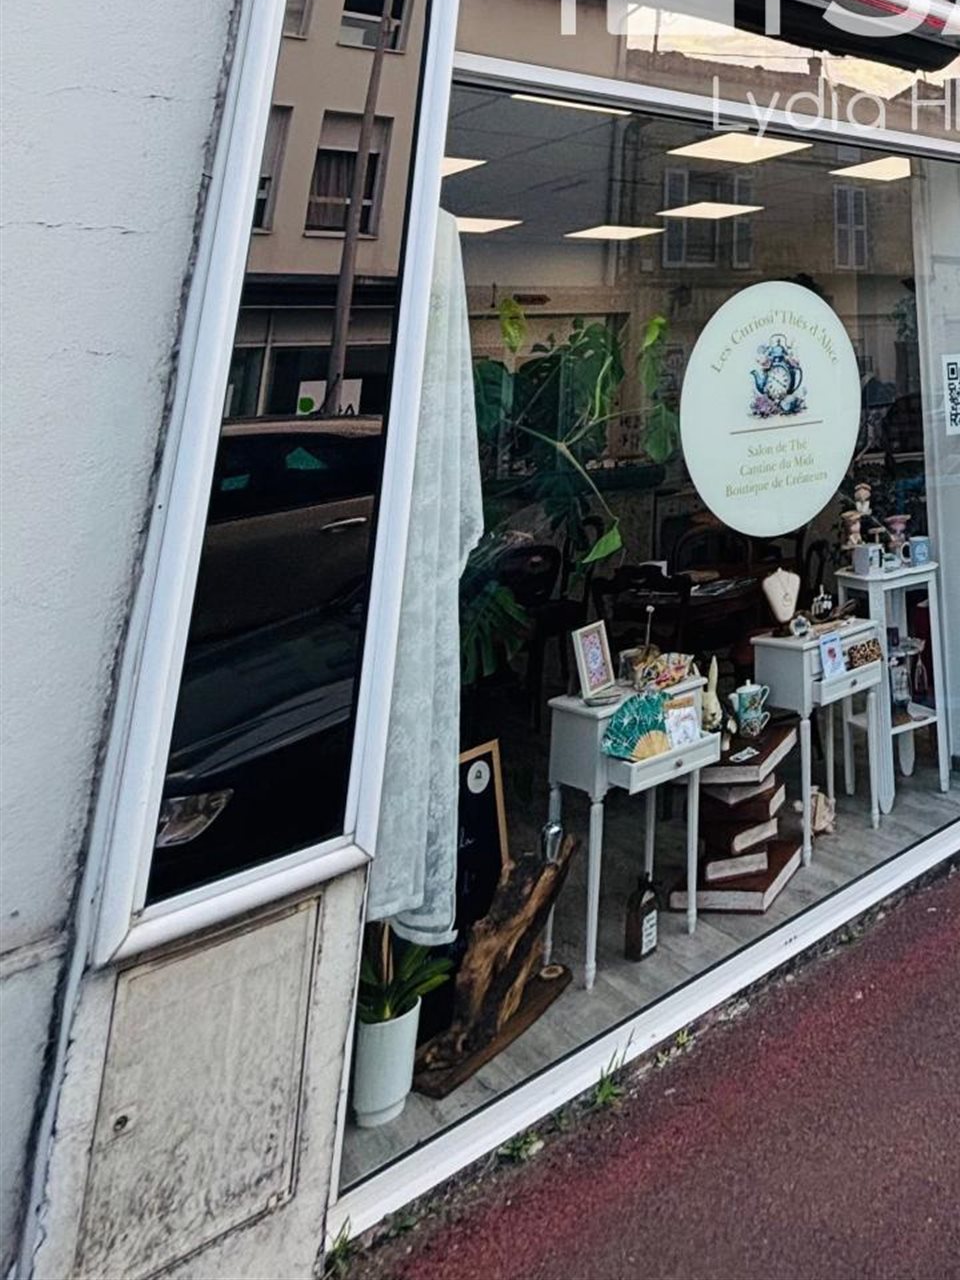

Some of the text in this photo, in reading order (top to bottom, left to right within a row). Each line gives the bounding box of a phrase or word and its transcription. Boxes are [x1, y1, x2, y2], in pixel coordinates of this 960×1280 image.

[711, 347, 732, 373] Les
[747, 438, 808, 458] Salon de Thé
[740, 453, 814, 476] Cantine du Midi
[725, 482, 769, 498] Boutique
[771, 476, 783, 489] de
